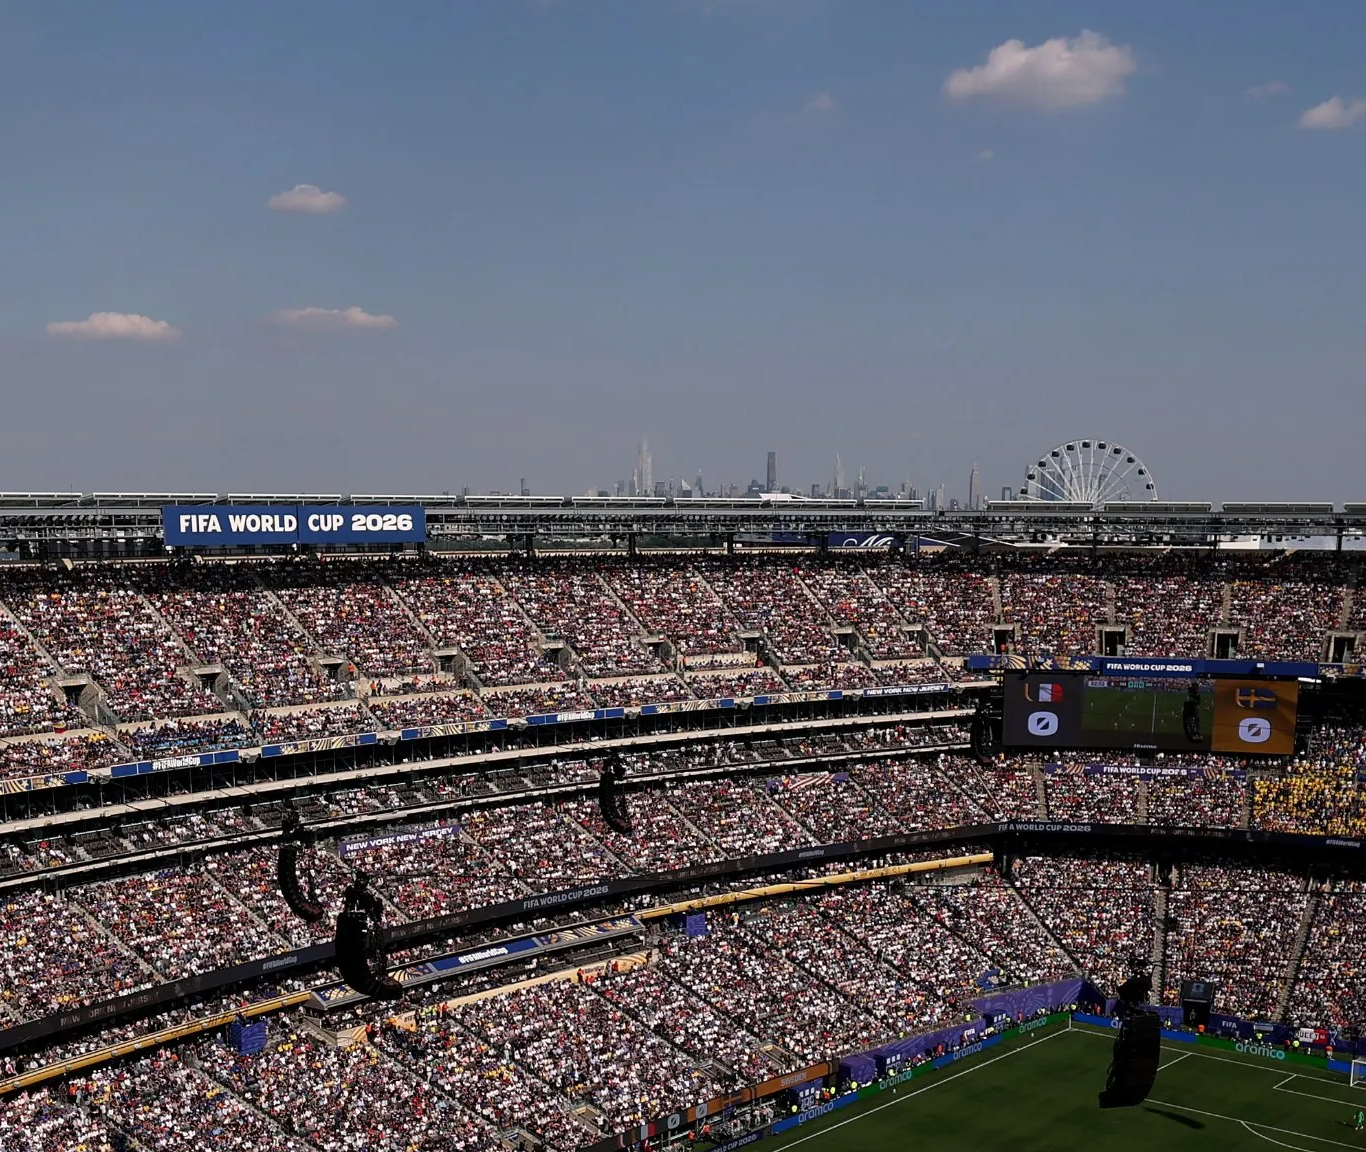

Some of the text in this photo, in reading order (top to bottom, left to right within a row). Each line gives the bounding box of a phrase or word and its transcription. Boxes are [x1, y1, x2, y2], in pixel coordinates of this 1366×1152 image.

[179, 513, 414, 532] FIFA WORLD CUP 2026
[998, 824, 1015, 832] FIFA
[1016, 824, 1045, 832] WORLD
[1046, 824, 1062, 832] CUP
[523, 885, 609, 909] FIFA WORLD CUP 2026
[1221, 1020, 1237, 1029] FIFA
[953, 1042, 982, 1060] aramco
[1235, 1043, 1285, 1060] aramco
[879, 1070, 912, 1090] aramco
[798, 1101, 834, 1123] aramco
[727, 1140, 739, 1150] CUP
[738, 1133, 757, 1146] 2026
